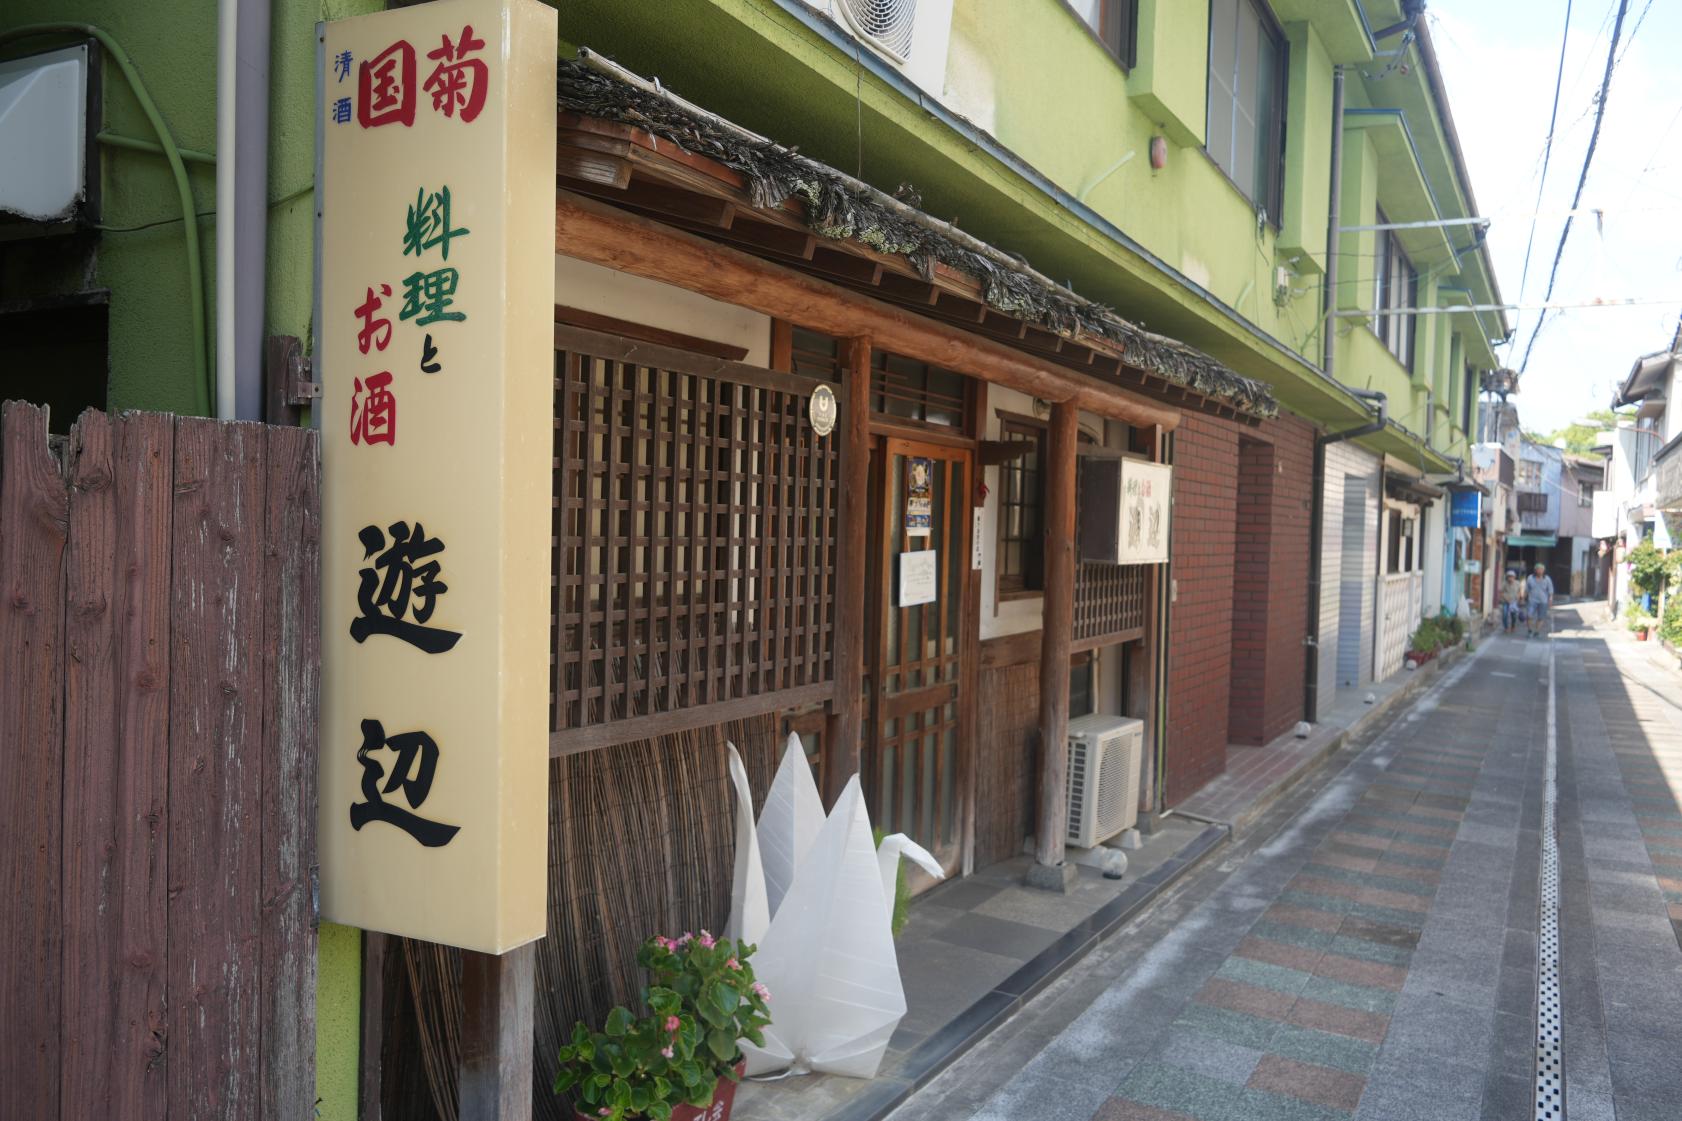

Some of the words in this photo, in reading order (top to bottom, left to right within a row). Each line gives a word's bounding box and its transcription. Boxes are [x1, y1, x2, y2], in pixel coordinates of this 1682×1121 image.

[333, 50, 353, 124] 清酒
[350, 284, 395, 446] お酒
[399, 185, 469, 373] 料理と
[349, 521, 462, 847] 遊辺
